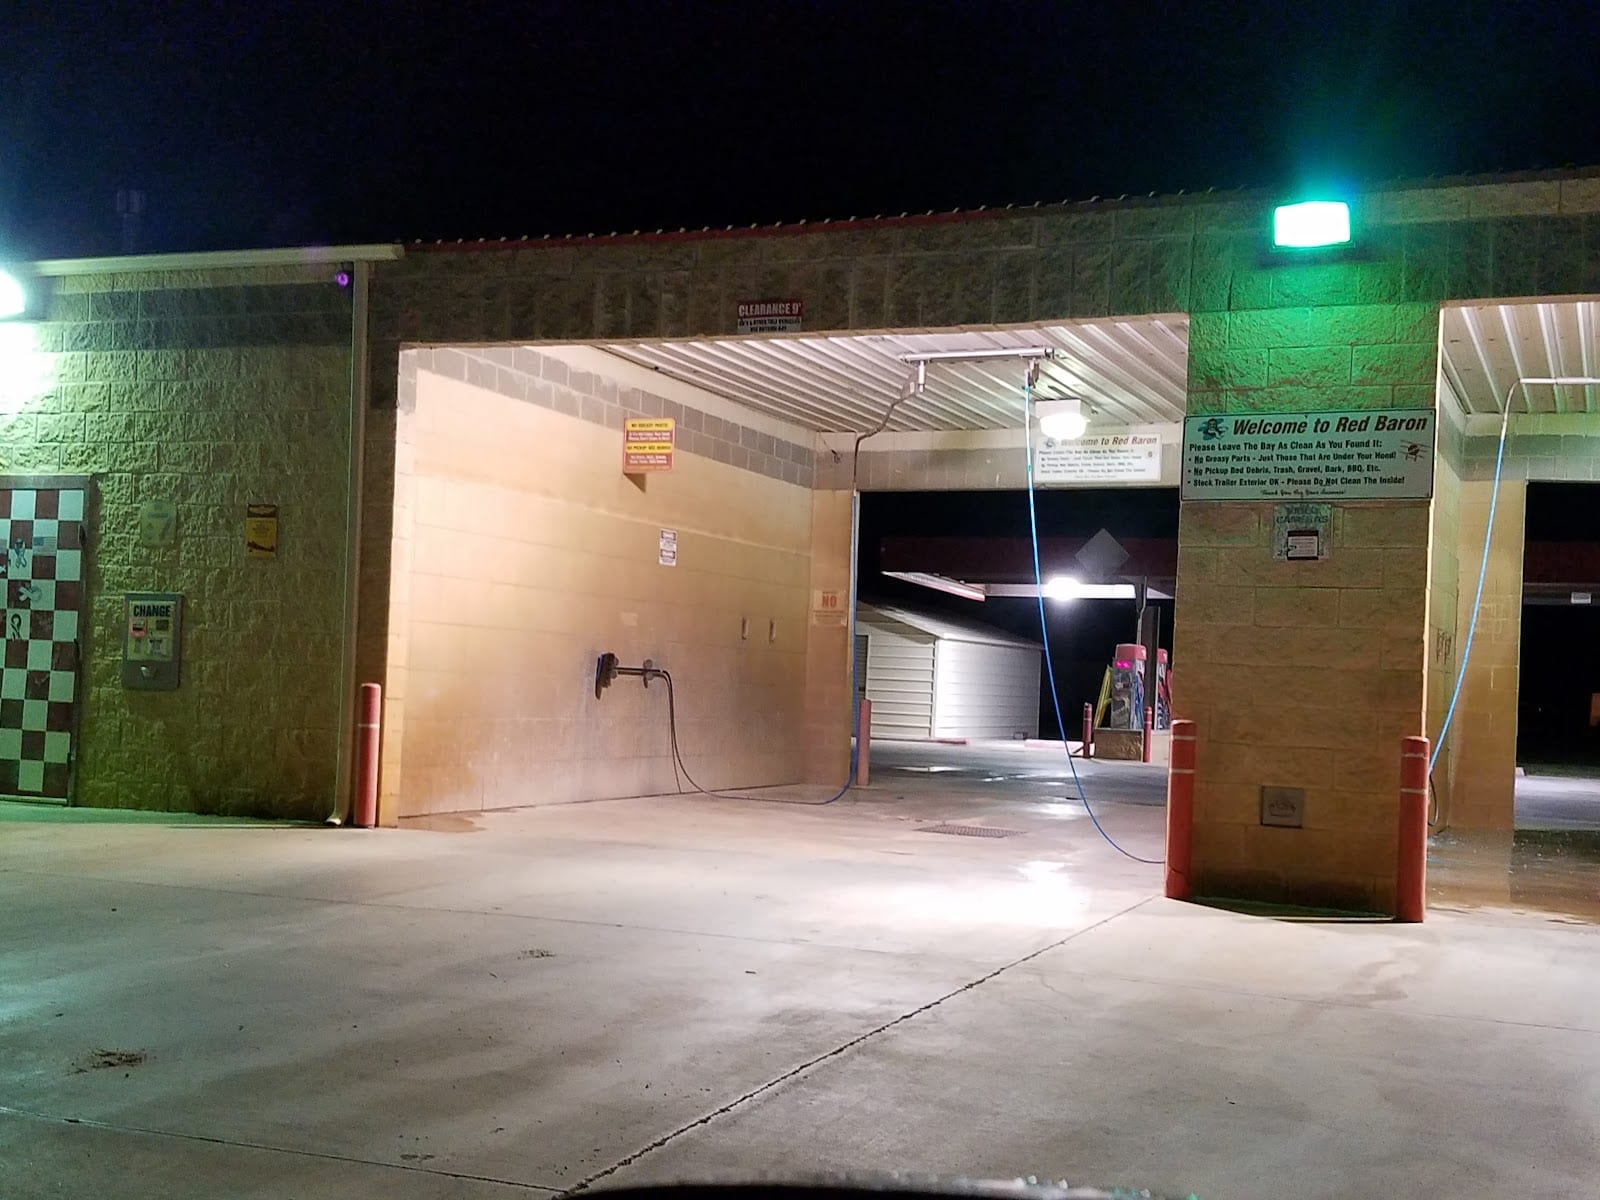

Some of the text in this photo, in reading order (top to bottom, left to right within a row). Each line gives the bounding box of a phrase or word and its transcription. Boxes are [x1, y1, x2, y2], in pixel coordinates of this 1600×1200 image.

[738, 303, 790, 316] CLEARANCE
[1233, 415, 1428, 435] Welcome to Red Baron
[1060, 436, 1158, 446] come to Red Baron
[1189, 444, 1216, 452] Please
[1218, 443, 1240, 451] Leave
[1244, 442, 1258, 450] The
[1260, 442, 1276, 451] Bay
[1278, 442, 1288, 450] As
[1290, 441, 1313, 450] Clean
[1316, 440, 1326, 448] As
[1328, 440, 1342, 448] You
[1346, 440, 1370, 448] Found
[1206, 456, 1230, 464] Greasy
[1258, 454, 1274, 462] Just
[1276, 454, 1297, 462] Those
[1333, 452, 1354, 460] Under
[1357, 452, 1372, 460] Your
[1204, 467, 1228, 475] Pickup
[1240, 478, 1267, 486] Exterior
[1269, 478, 1279, 486] OK
[1314, 478, 1323, 486] Do
[1326, 477, 1338, 486] Not
[1340, 477, 1360, 485] Clean
[1364, 476, 1377, 484] The
[822, 596, 837, 608] NO
[133, 605, 171, 617] CHANGE
